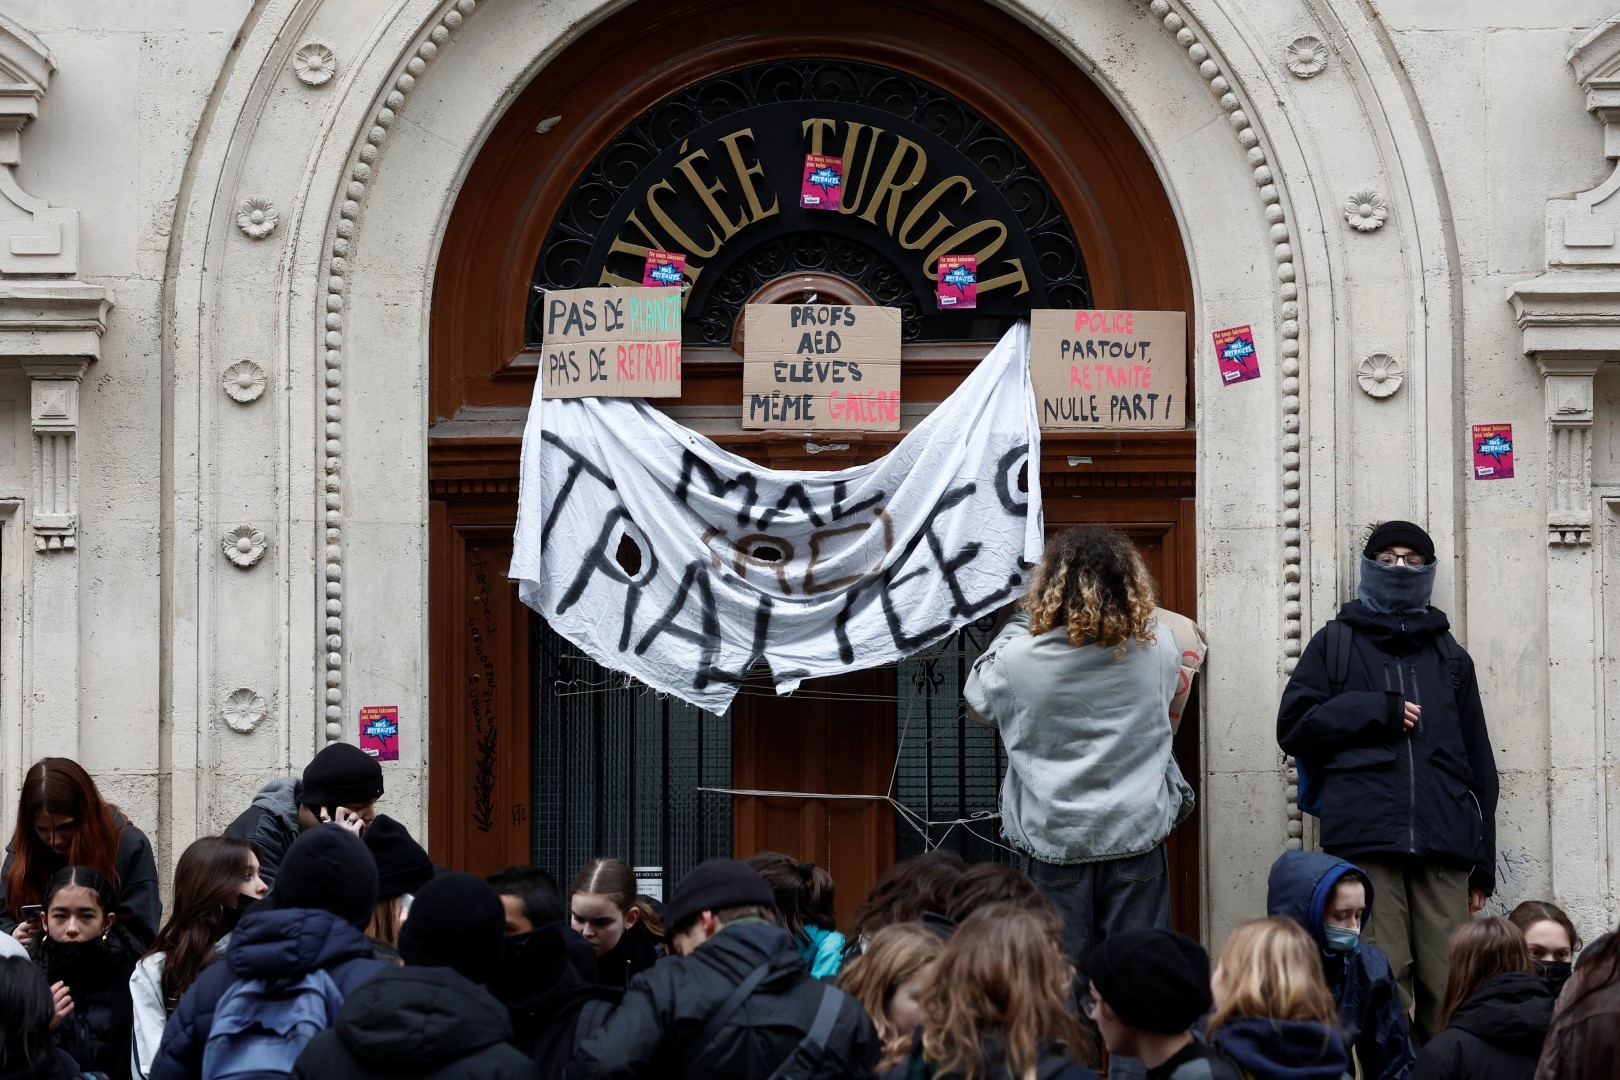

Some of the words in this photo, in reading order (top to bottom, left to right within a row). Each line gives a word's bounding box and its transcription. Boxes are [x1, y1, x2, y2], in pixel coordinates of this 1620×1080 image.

[597, 127, 780, 311] YCÉE
[801, 117, 1030, 300] TURGOT
[548, 299, 597, 336] PAS
[604, 298, 624, 332] DE
[790, 306, 856, 328] PROFS
[1074, 310, 1134, 334] POLICE
[796, 330, 842, 355] AED
[1060, 339, 1152, 363] PARTOUT,
[549, 350, 580, 387] PAS
[589, 347, 607, 382] DE
[616, 342, 681, 383] RETRAITE
[750, 389, 816, 423] MÊME
[1044, 394, 1100, 424] NULLE
[1110, 393, 1160, 422] PART
[676, 448, 885, 531] MAL
